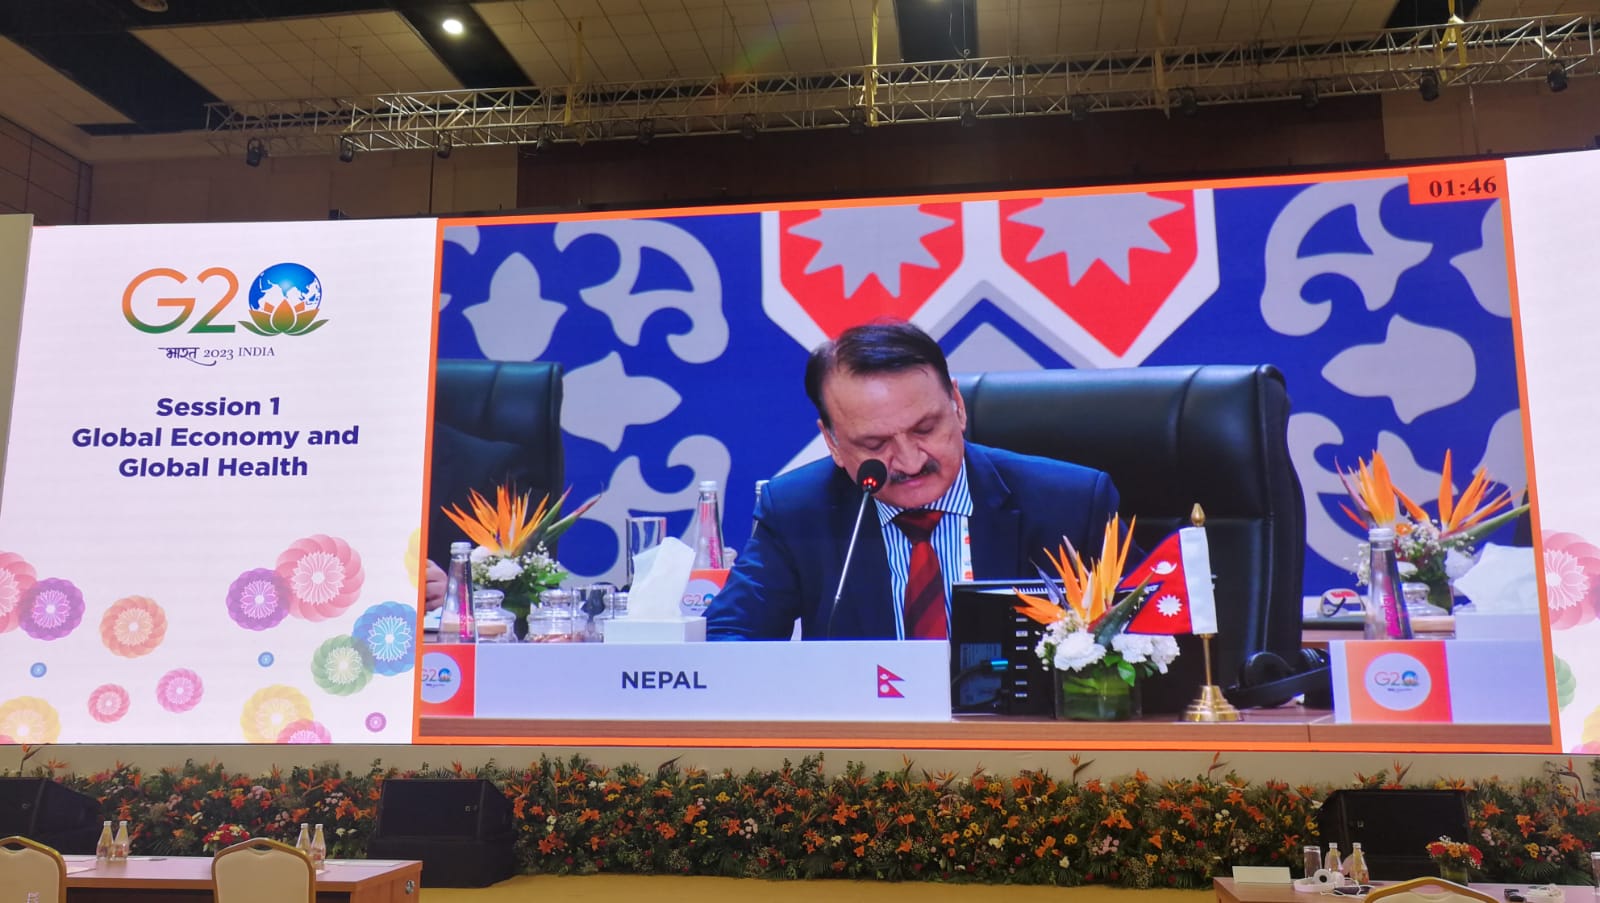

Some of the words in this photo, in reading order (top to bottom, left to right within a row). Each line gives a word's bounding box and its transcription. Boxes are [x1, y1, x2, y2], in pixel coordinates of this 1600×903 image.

[1429, 176, 1497, 198] 01:46
[121, 262, 330, 337] G20
[203, 349, 234, 360] 2023
[238, 346, 276, 357] INDIA
[156, 397, 261, 417] Session
[269, 397, 280, 415] 1
[72, 427, 162, 447] Global
[171, 427, 300, 449] Economy
[307, 425, 359, 445] and
[119, 457, 209, 477] Global
[218, 456, 308, 476] Health
[621, 671, 707, 689] NEPAL
[1374, 670, 1419, 687] G20
